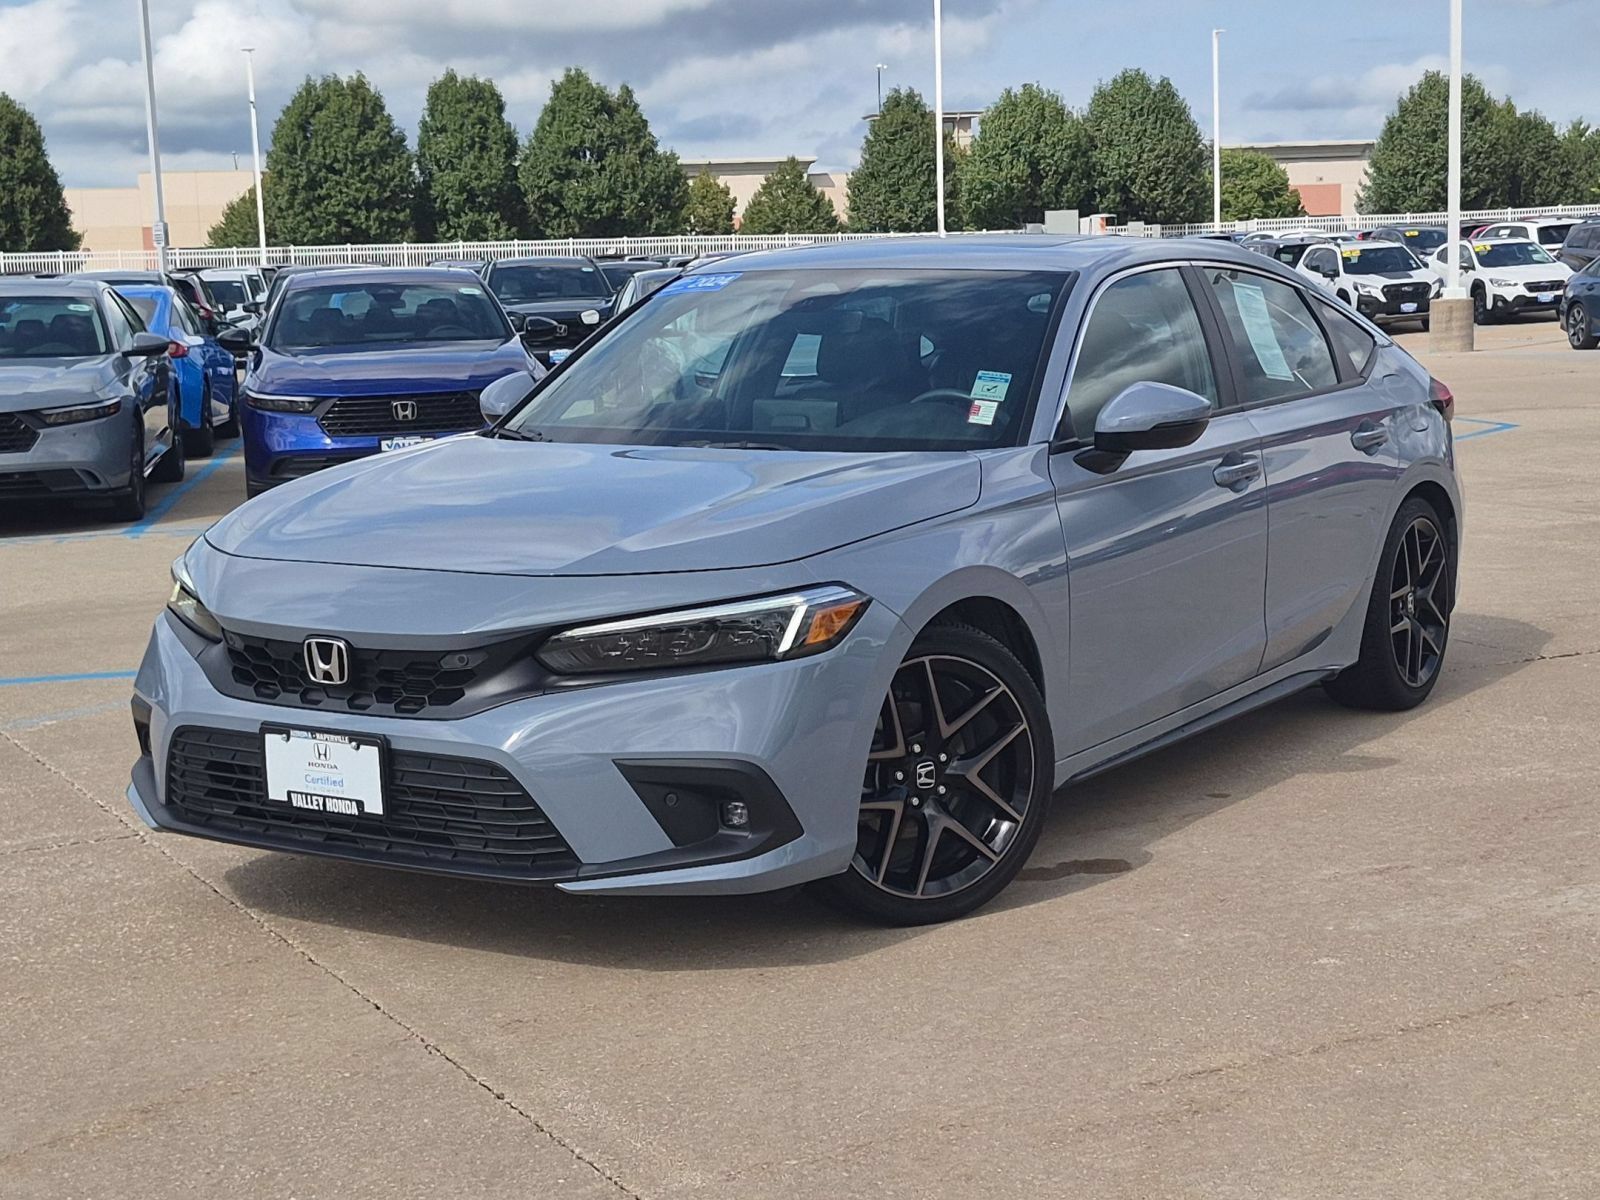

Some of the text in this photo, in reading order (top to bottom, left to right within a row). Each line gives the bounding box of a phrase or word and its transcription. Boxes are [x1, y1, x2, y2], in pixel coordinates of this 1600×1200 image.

[308, 761, 338, 770] HONDA
[304, 774, 344, 788] Certified
[290, 793, 359, 816] VALLEY HONDA
